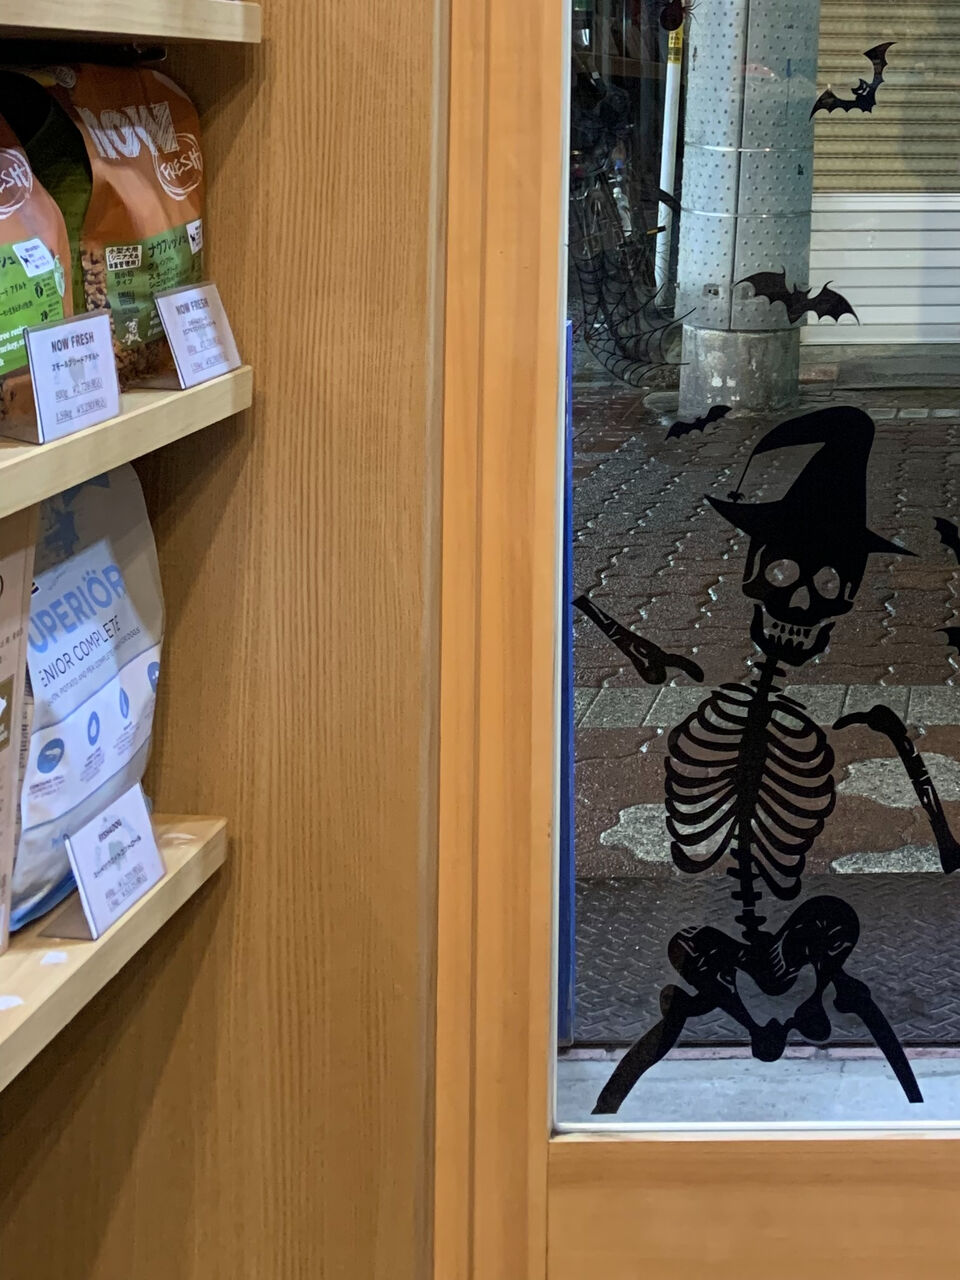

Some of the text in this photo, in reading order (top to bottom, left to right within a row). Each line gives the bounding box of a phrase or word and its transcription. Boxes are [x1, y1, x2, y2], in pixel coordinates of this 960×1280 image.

[160, 148, 202, 180] FRESH
[51, 332, 95, 353] NOW FRESH
[28, 564, 126, 654] UPERIOR
